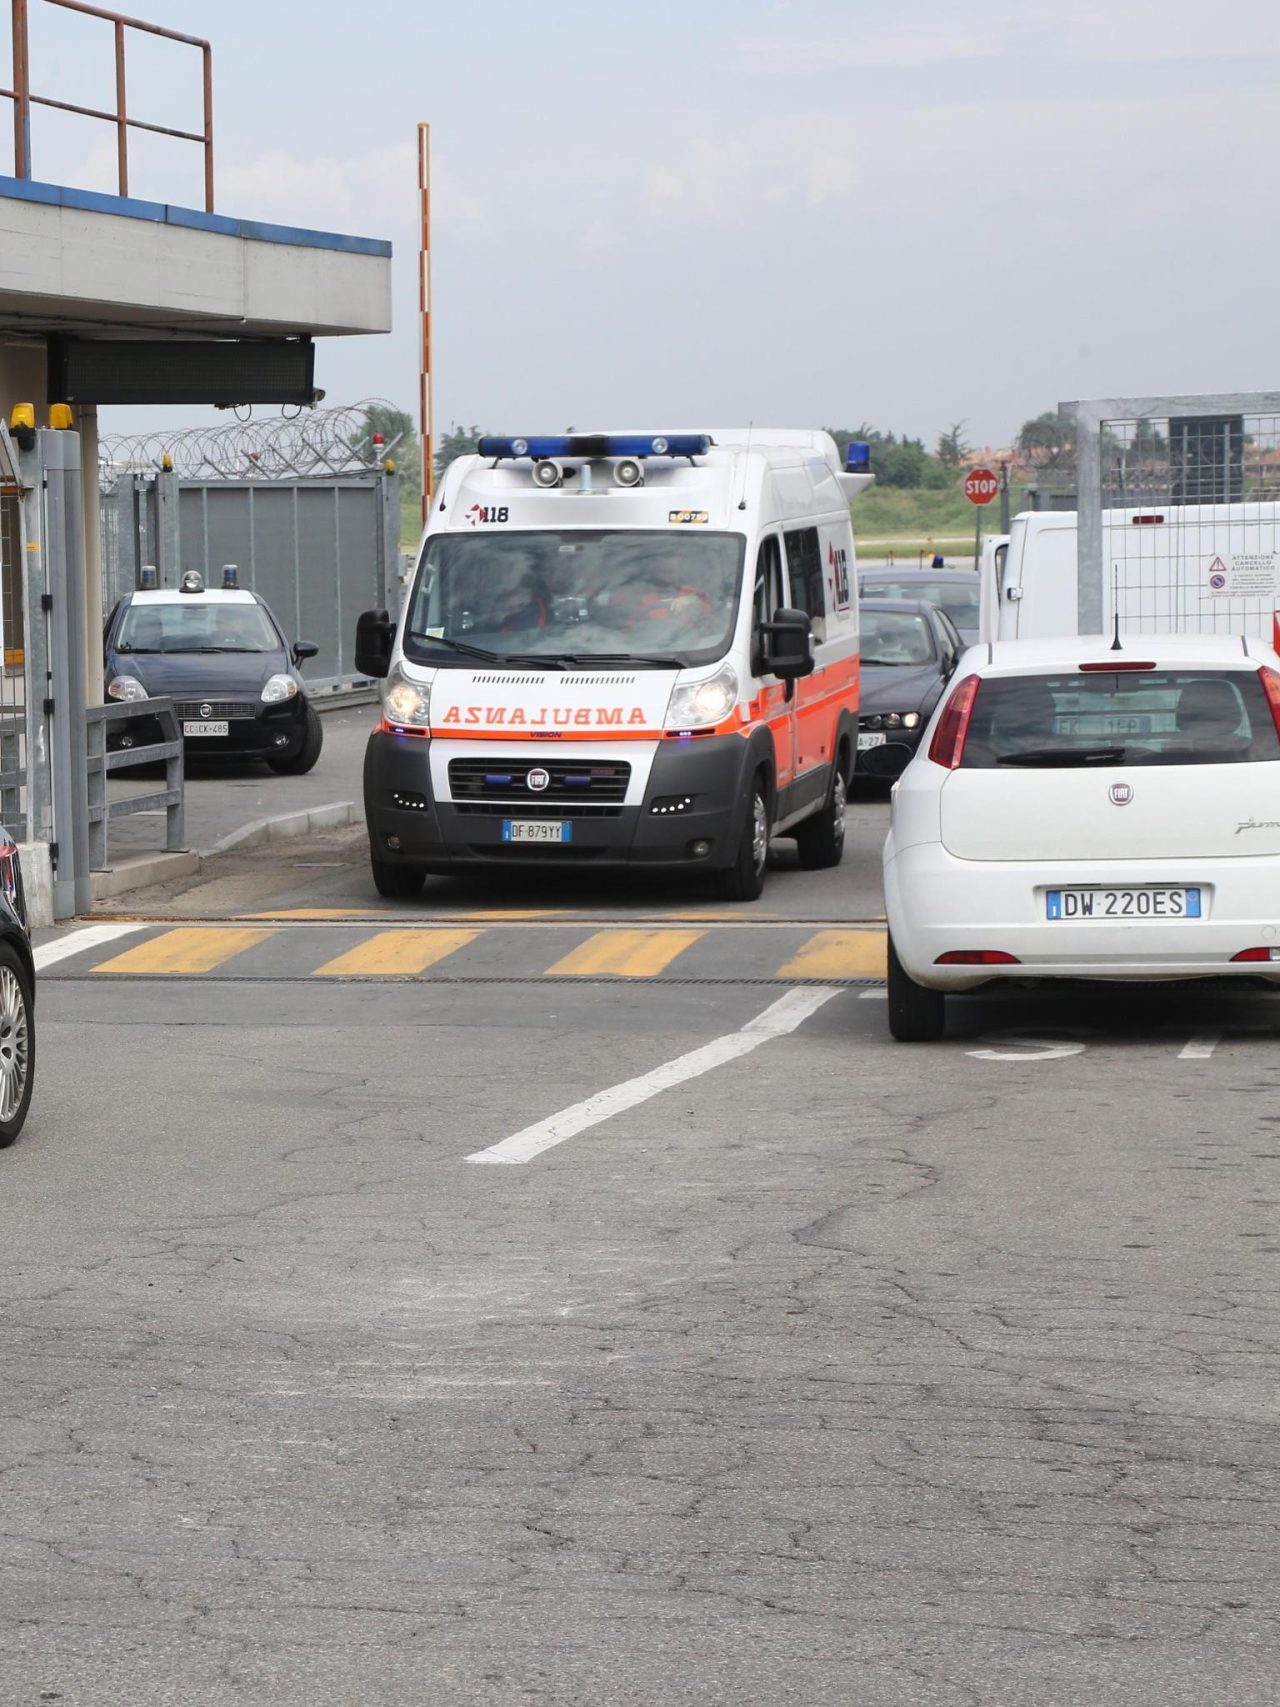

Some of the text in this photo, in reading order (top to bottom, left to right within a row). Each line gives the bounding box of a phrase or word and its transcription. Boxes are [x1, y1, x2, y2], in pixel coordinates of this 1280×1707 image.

[966, 480, 997, 494] STOP
[483, 507, 508, 523] 118
[1114, 788, 1129, 799] FIAT
[512, 825, 524, 838] DF
[527, 825, 561, 838] 879YY
[1064, 892, 1094, 916] DW
[1104, 891, 1183, 915] 220ES
